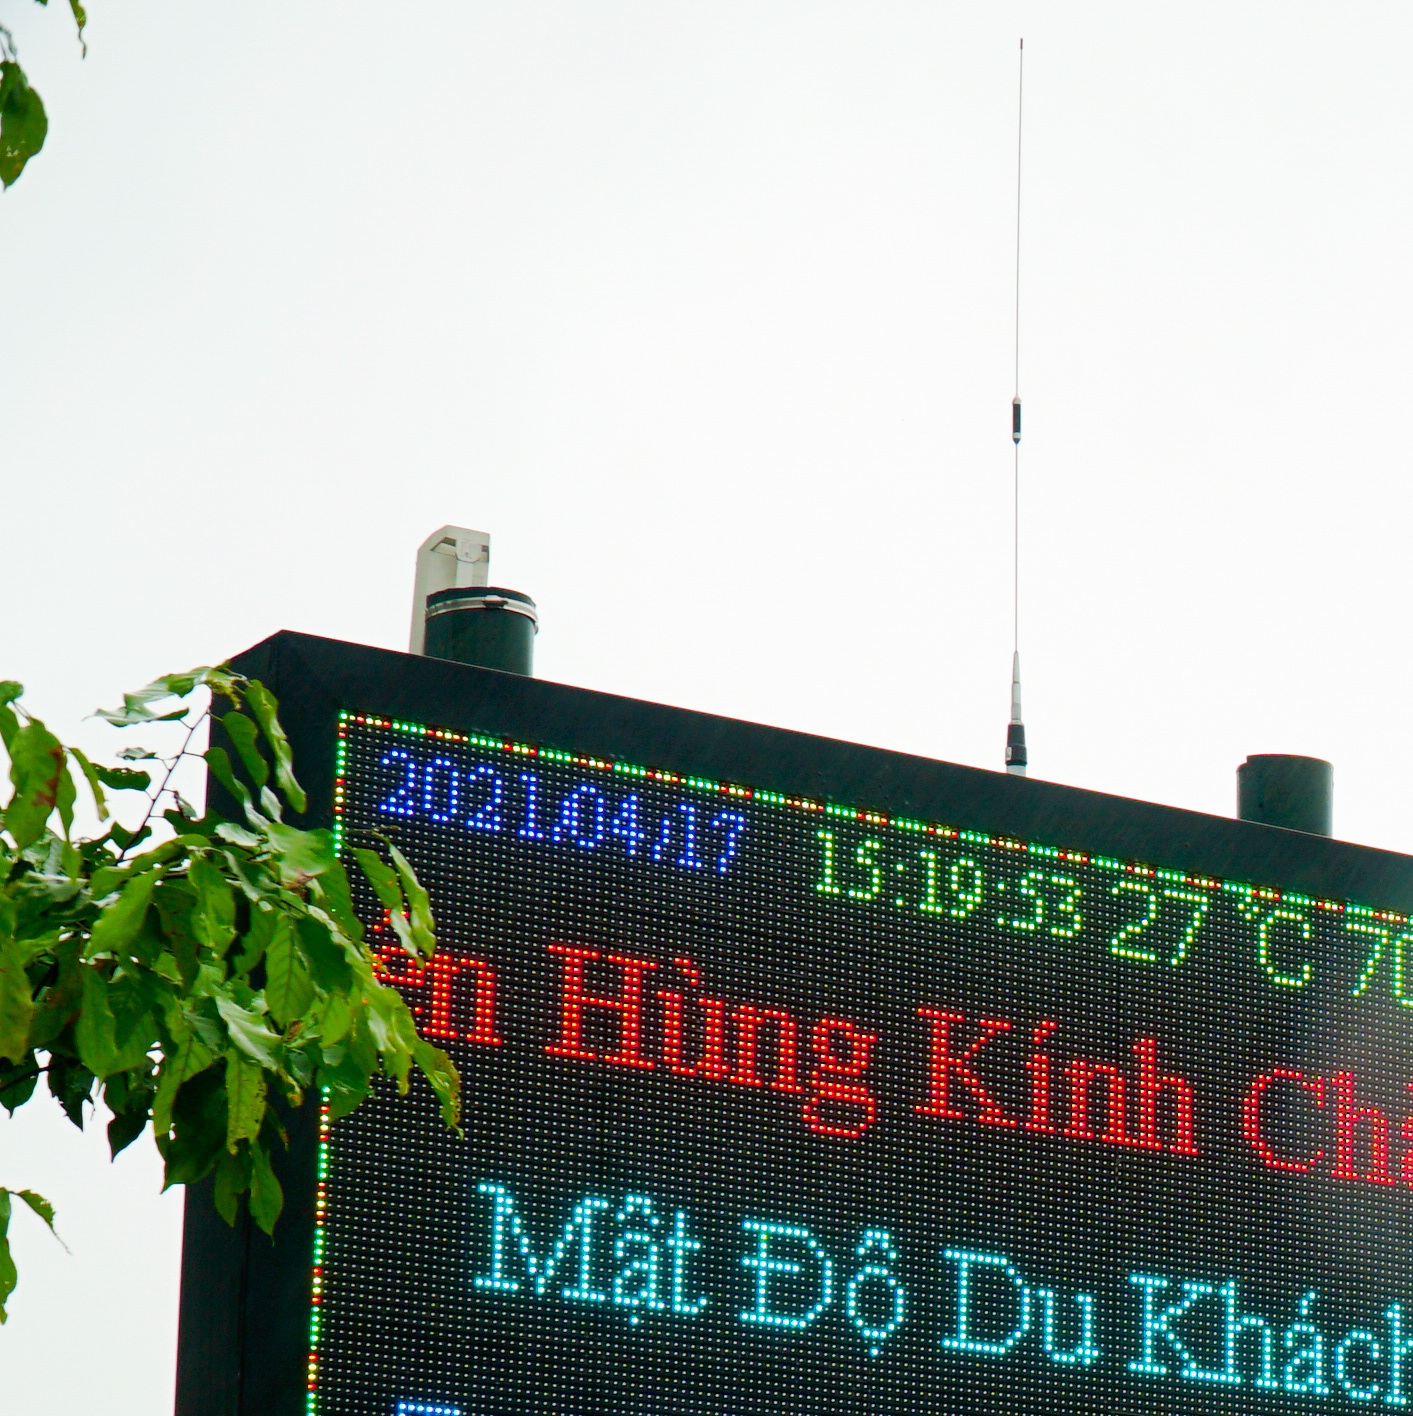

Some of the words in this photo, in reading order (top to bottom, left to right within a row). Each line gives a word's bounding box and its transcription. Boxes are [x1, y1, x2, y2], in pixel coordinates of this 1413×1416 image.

[814, 829, 1083, 939] 15:19:53
[1110, 880, 1210, 966] 27
[544, 942, 878, 1139] Hùng
[912, 1004, 1200, 1158] Kính
[475, 1182, 708, 1325] Mật
[741, 1220, 905, 1357] Độ
[942, 1247, 1100, 1368] Du
